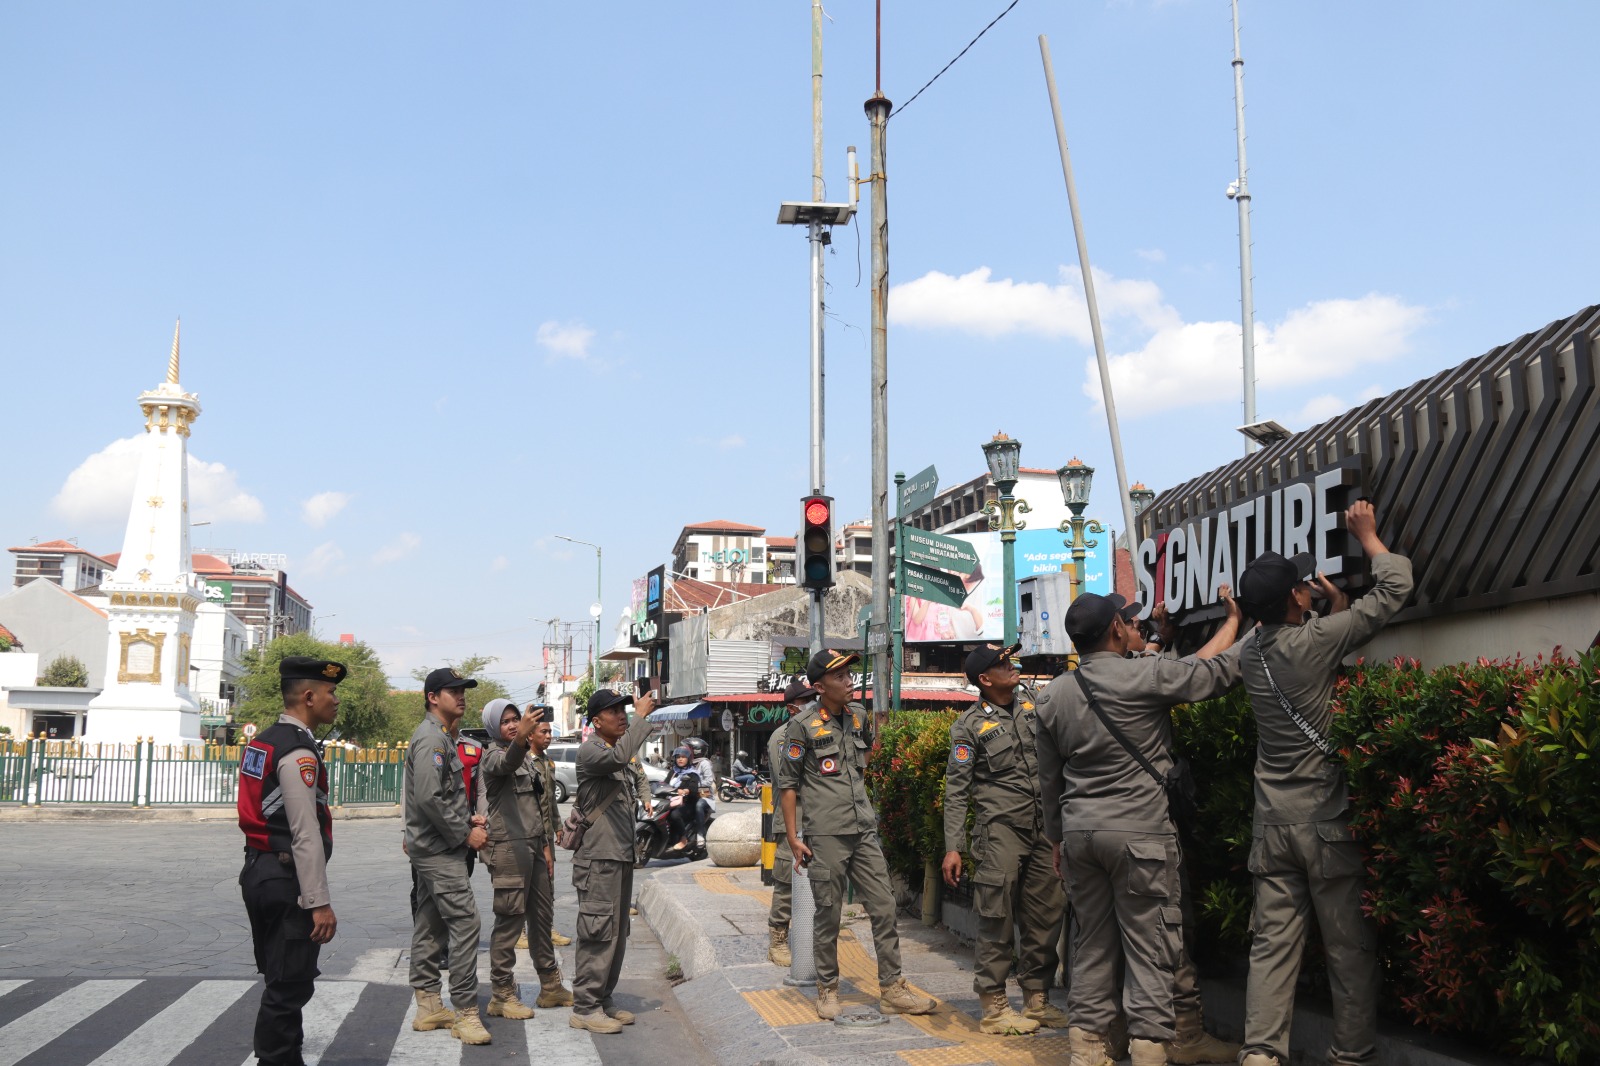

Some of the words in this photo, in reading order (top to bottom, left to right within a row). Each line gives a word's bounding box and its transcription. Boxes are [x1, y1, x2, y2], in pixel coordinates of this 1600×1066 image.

[910, 534, 934, 546] MUSEUM
[935, 540, 959, 552] DHARMA
[231, 553, 287, 565] HARPER
[702, 551, 723, 563] THE
[723, 548, 749, 564] 101
[929, 547, 959, 560] WIRATAMA
[1033, 563, 1057, 573] bikin
[907, 569, 924, 580] PASAR
[924, 573, 949, 586] KRANGGAN
